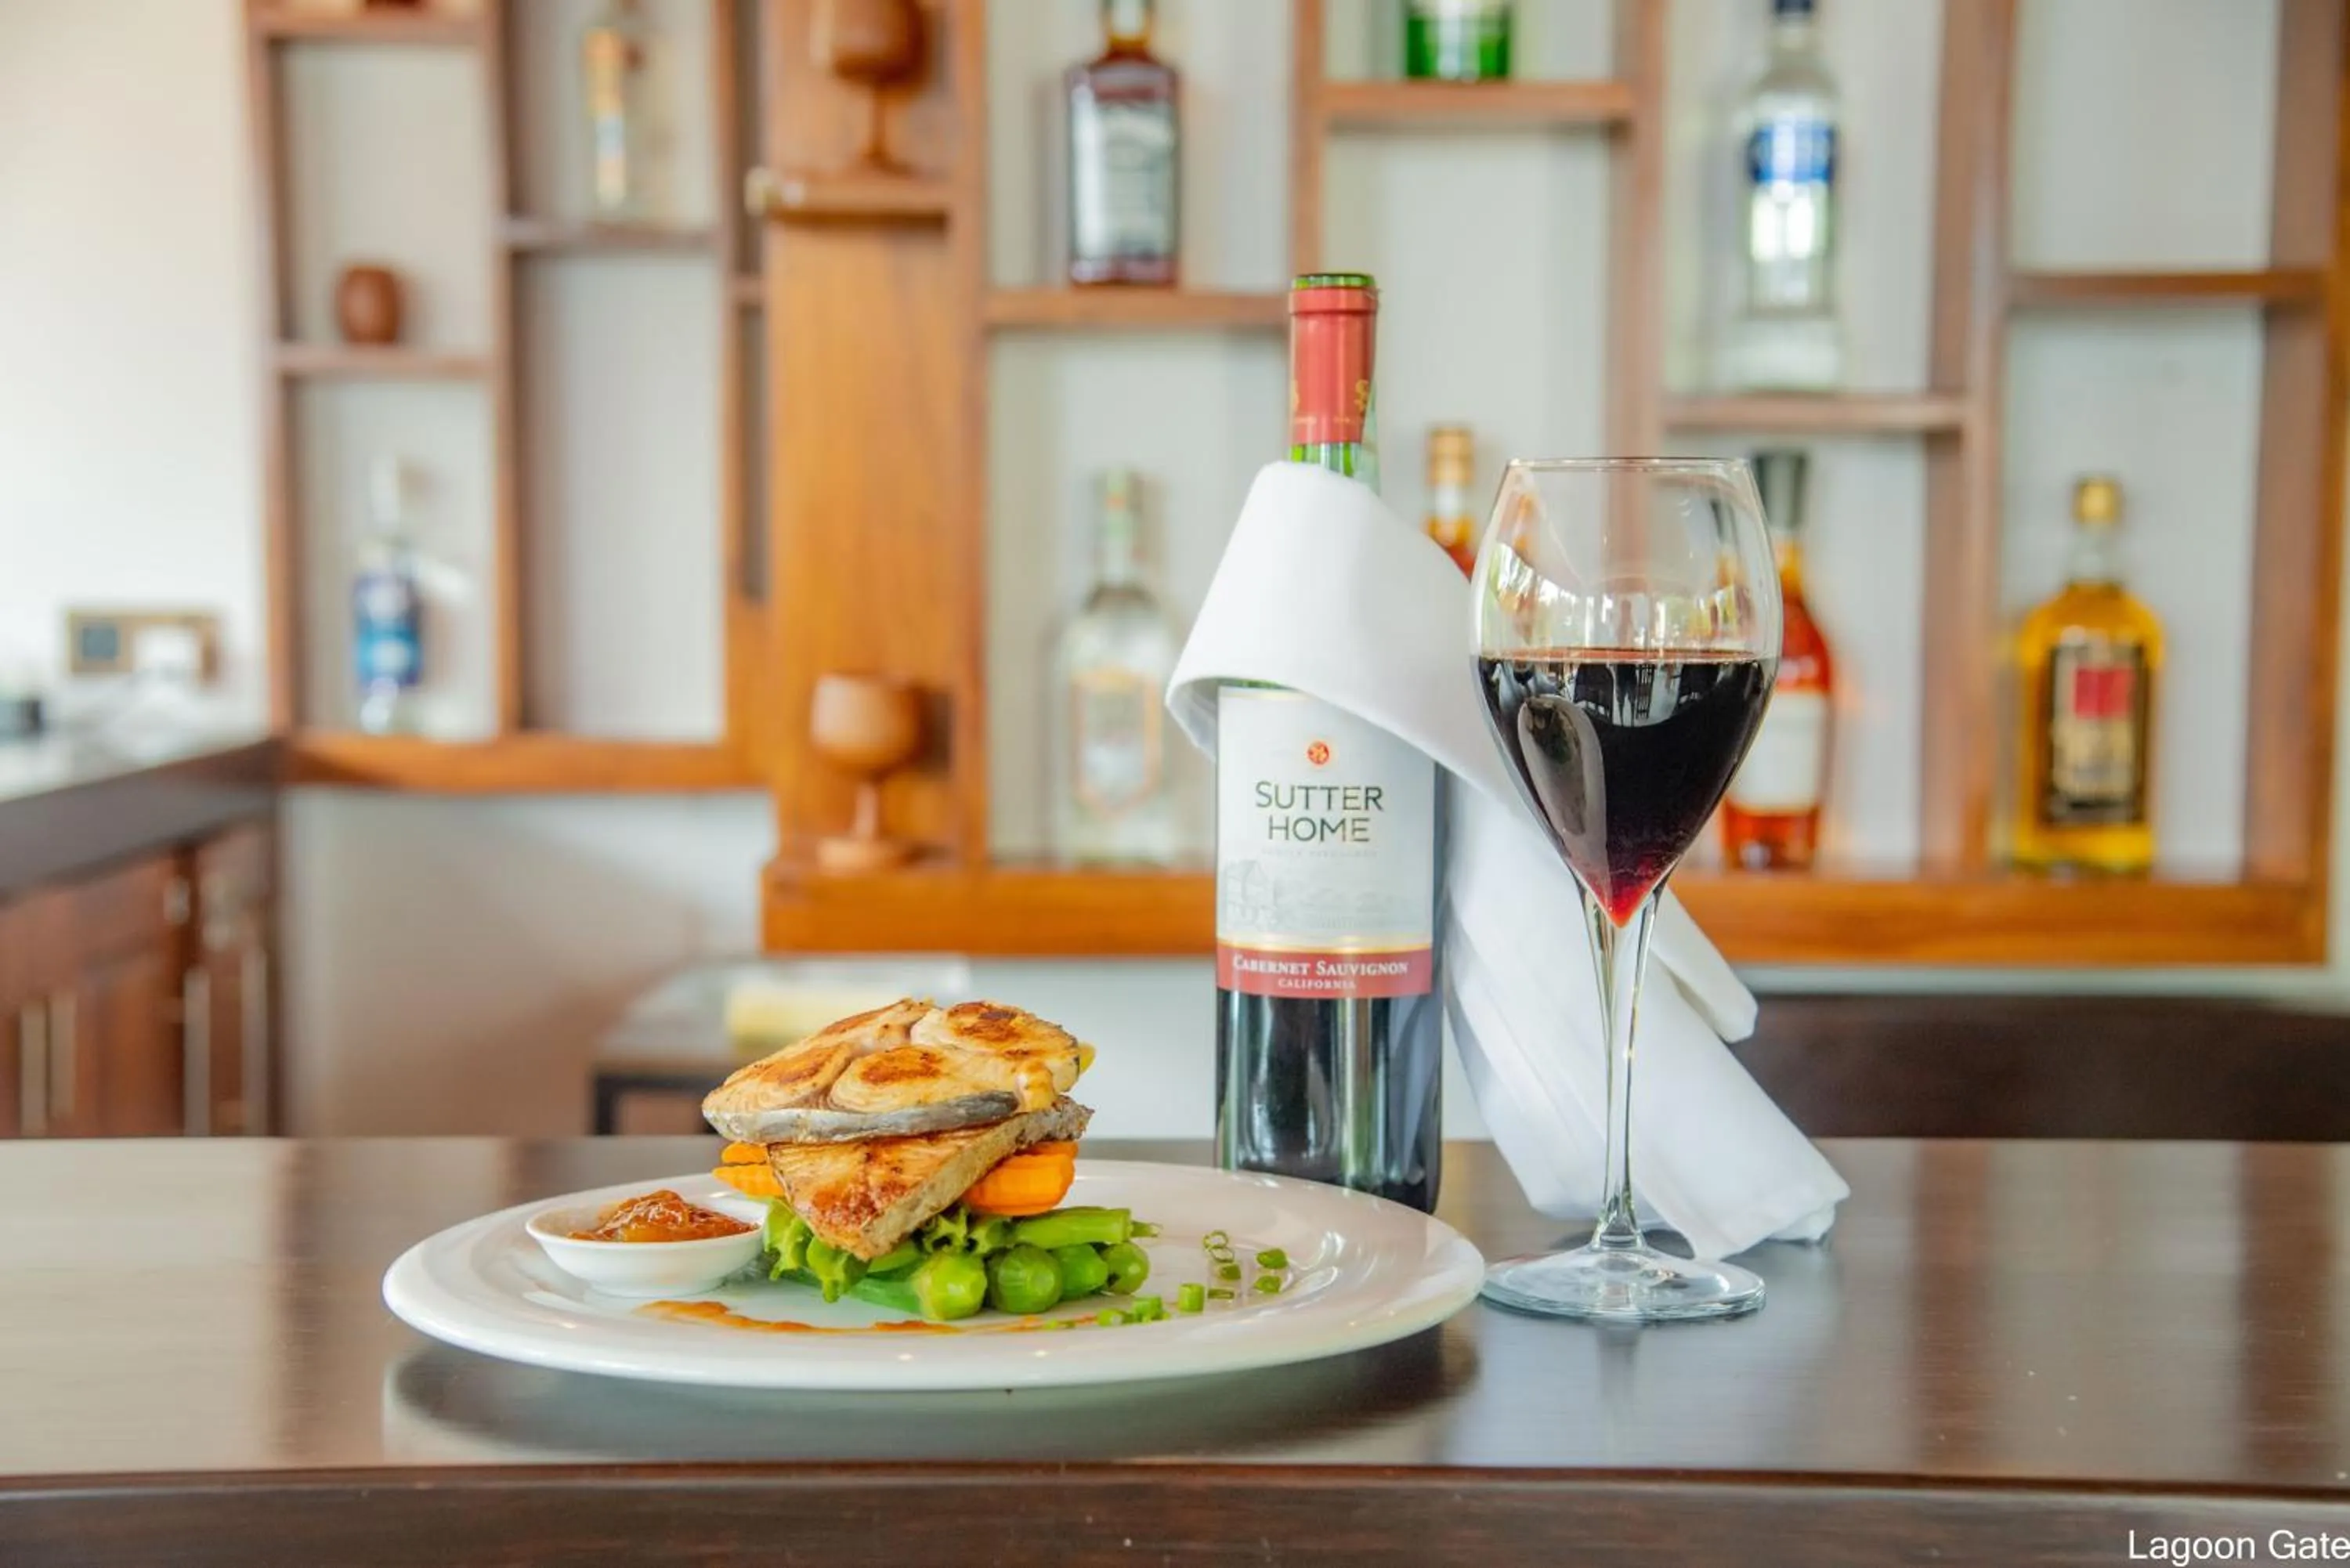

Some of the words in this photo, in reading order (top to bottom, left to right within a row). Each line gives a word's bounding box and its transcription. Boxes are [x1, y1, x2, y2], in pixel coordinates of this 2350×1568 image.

[1255, 781, 1384, 811] SUTTER
[1268, 815, 1371, 842] HOME
[1233, 953, 1311, 976] CABERNET
[1316, 960, 1408, 977] SAUVIGNON
[1278, 977, 1356, 990] CALIFORNIA
